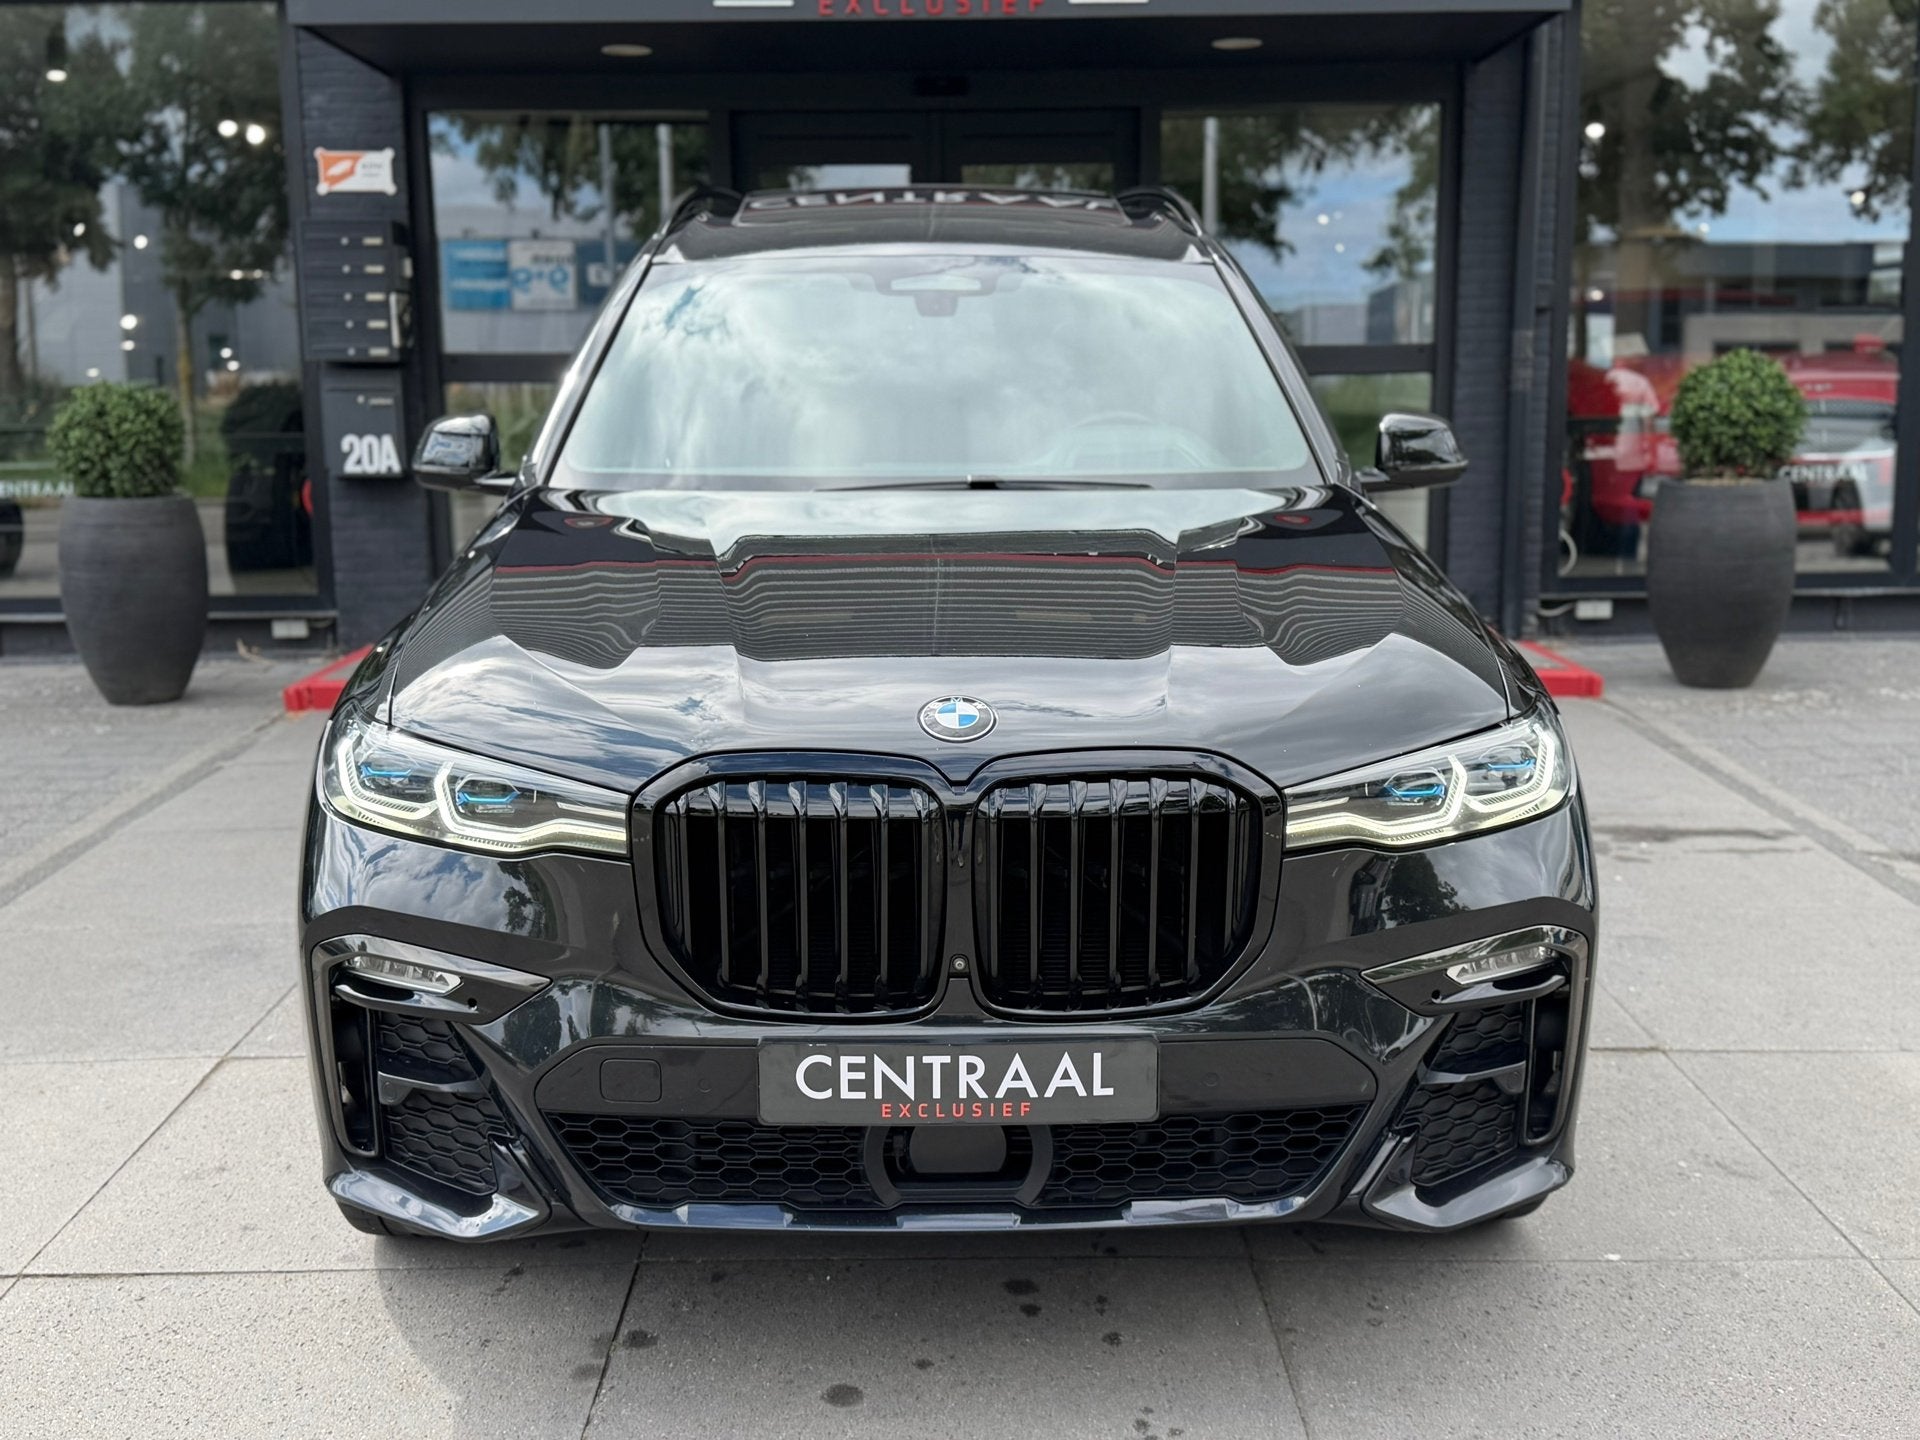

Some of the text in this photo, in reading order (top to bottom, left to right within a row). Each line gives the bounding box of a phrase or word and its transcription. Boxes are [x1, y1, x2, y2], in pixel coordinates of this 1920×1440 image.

[341, 433, 401, 474] 20A
[796, 1051, 1114, 1101] CENTRAAL
[882, 1102, 1031, 1118] EXCLUSIEF
